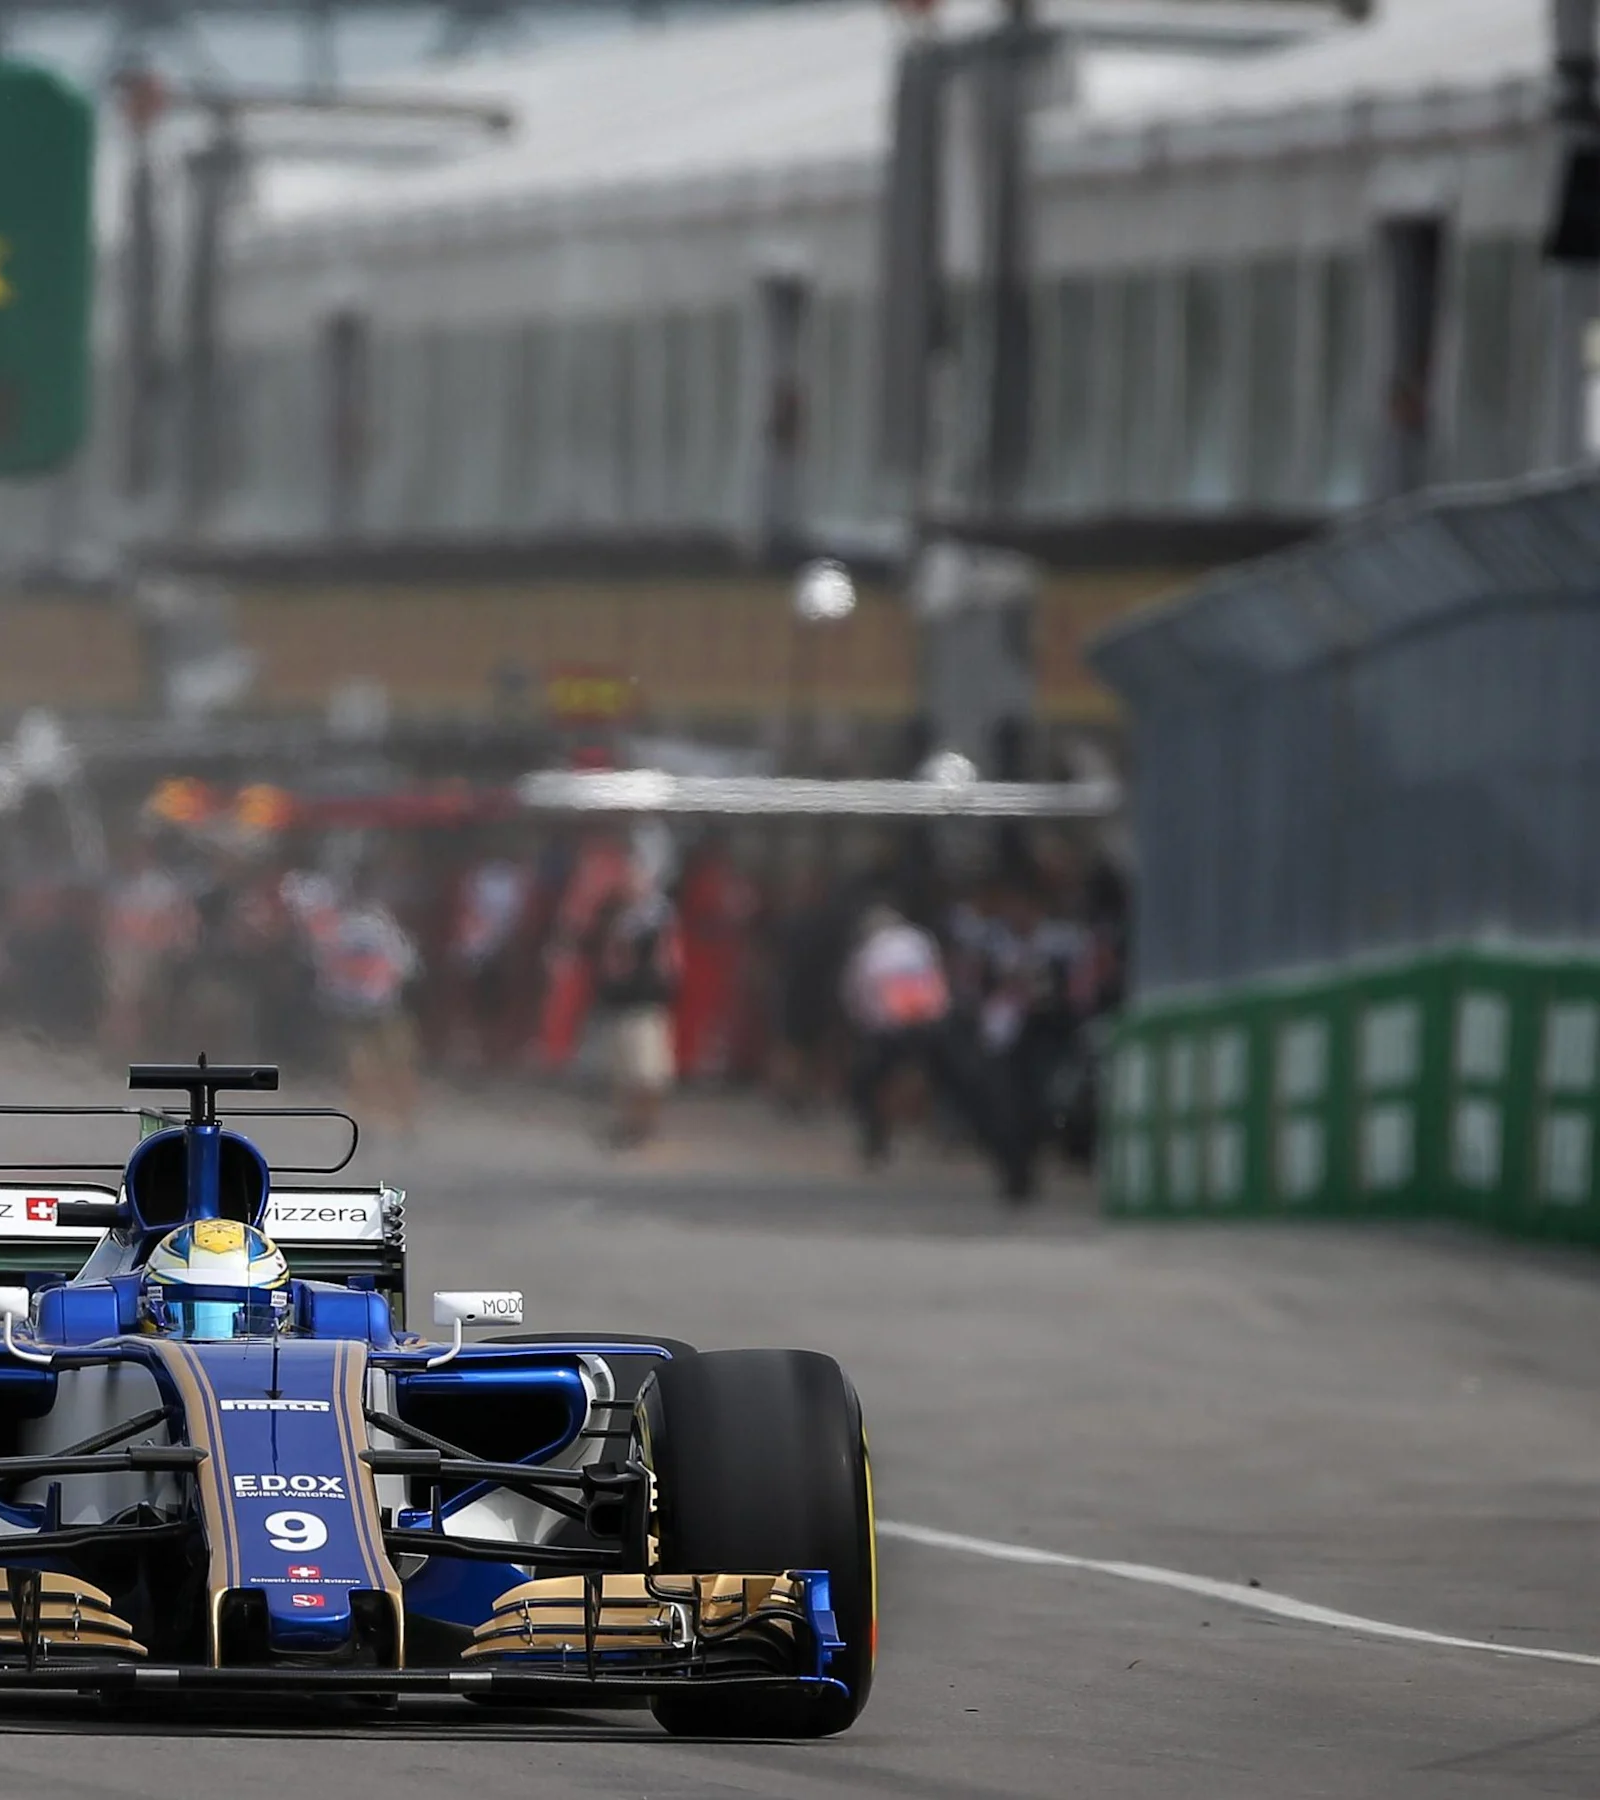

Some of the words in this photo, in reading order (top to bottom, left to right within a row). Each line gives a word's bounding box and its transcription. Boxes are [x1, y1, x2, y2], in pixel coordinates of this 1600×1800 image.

[233, 1475, 344, 1493] EDOX
[235, 1490, 280, 1498] Swiss
[282, 1490, 346, 1499] Watches
[265, 1511, 328, 1551] 9
